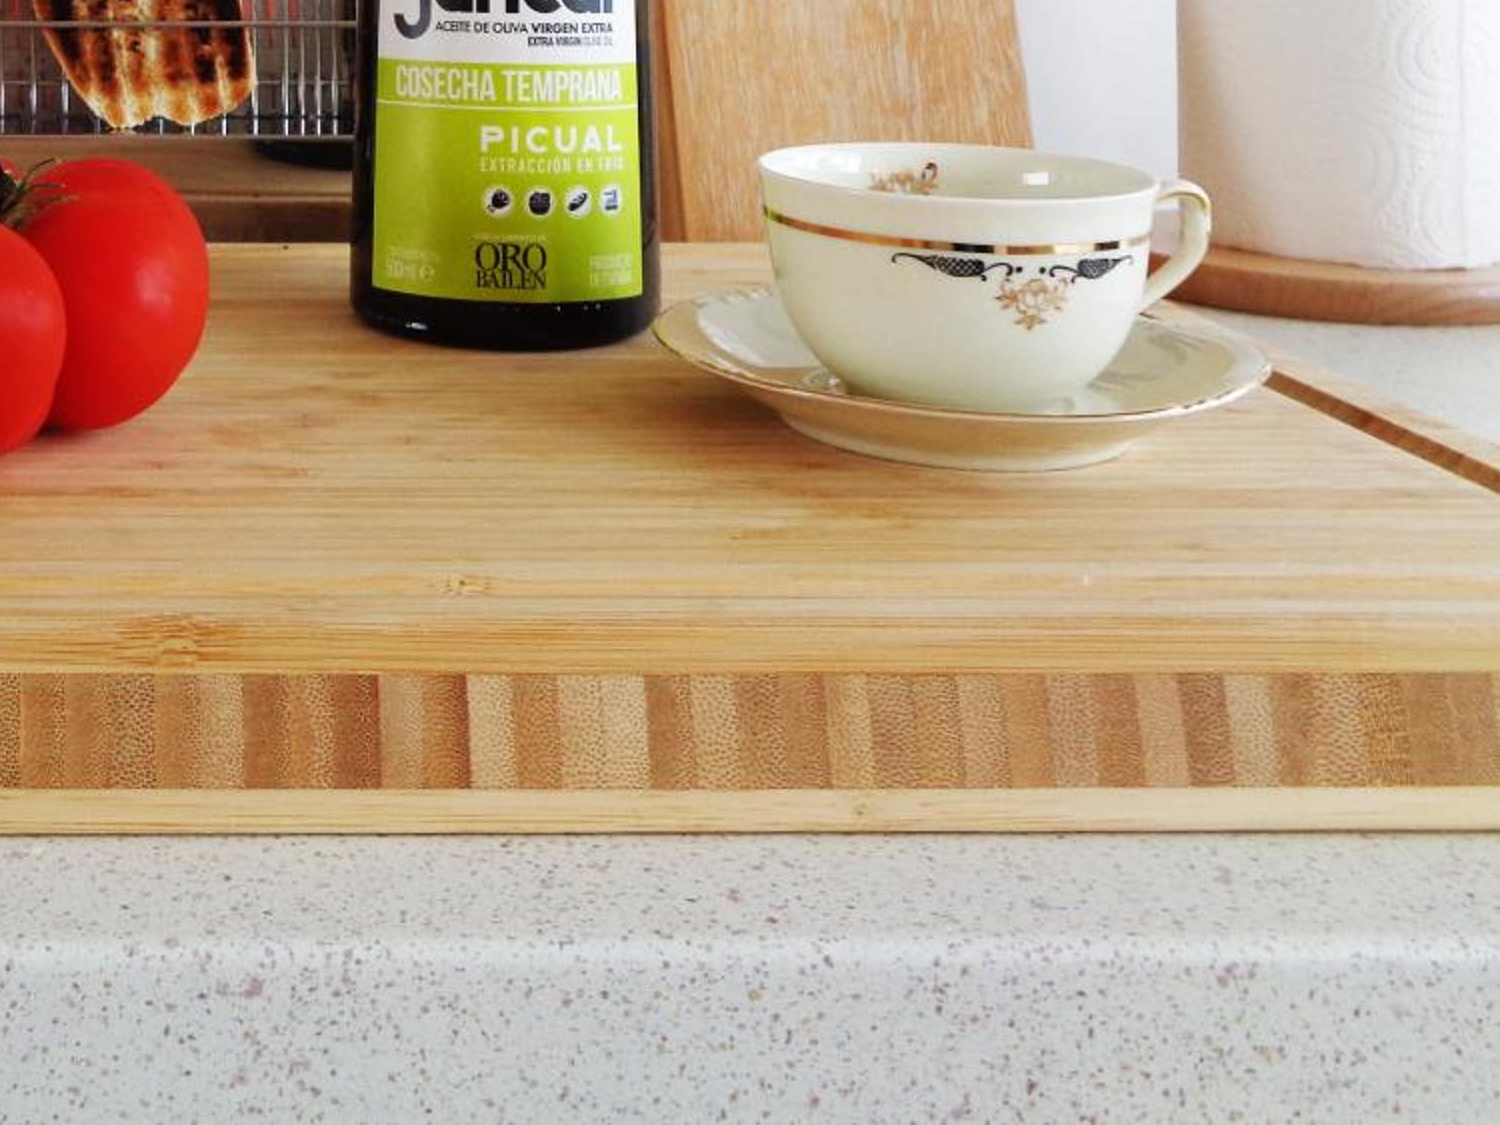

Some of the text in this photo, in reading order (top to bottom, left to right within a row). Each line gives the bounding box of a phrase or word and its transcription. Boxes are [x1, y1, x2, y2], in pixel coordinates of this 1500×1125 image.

[436, 20, 613, 33] ACEITE DE OLIVA VIRGEN EXTRA
[396, 65, 622, 102] COSECHA TEMPRANA
[480, 125, 622, 154] PICUAL
[475, 242, 547, 273] ORO
